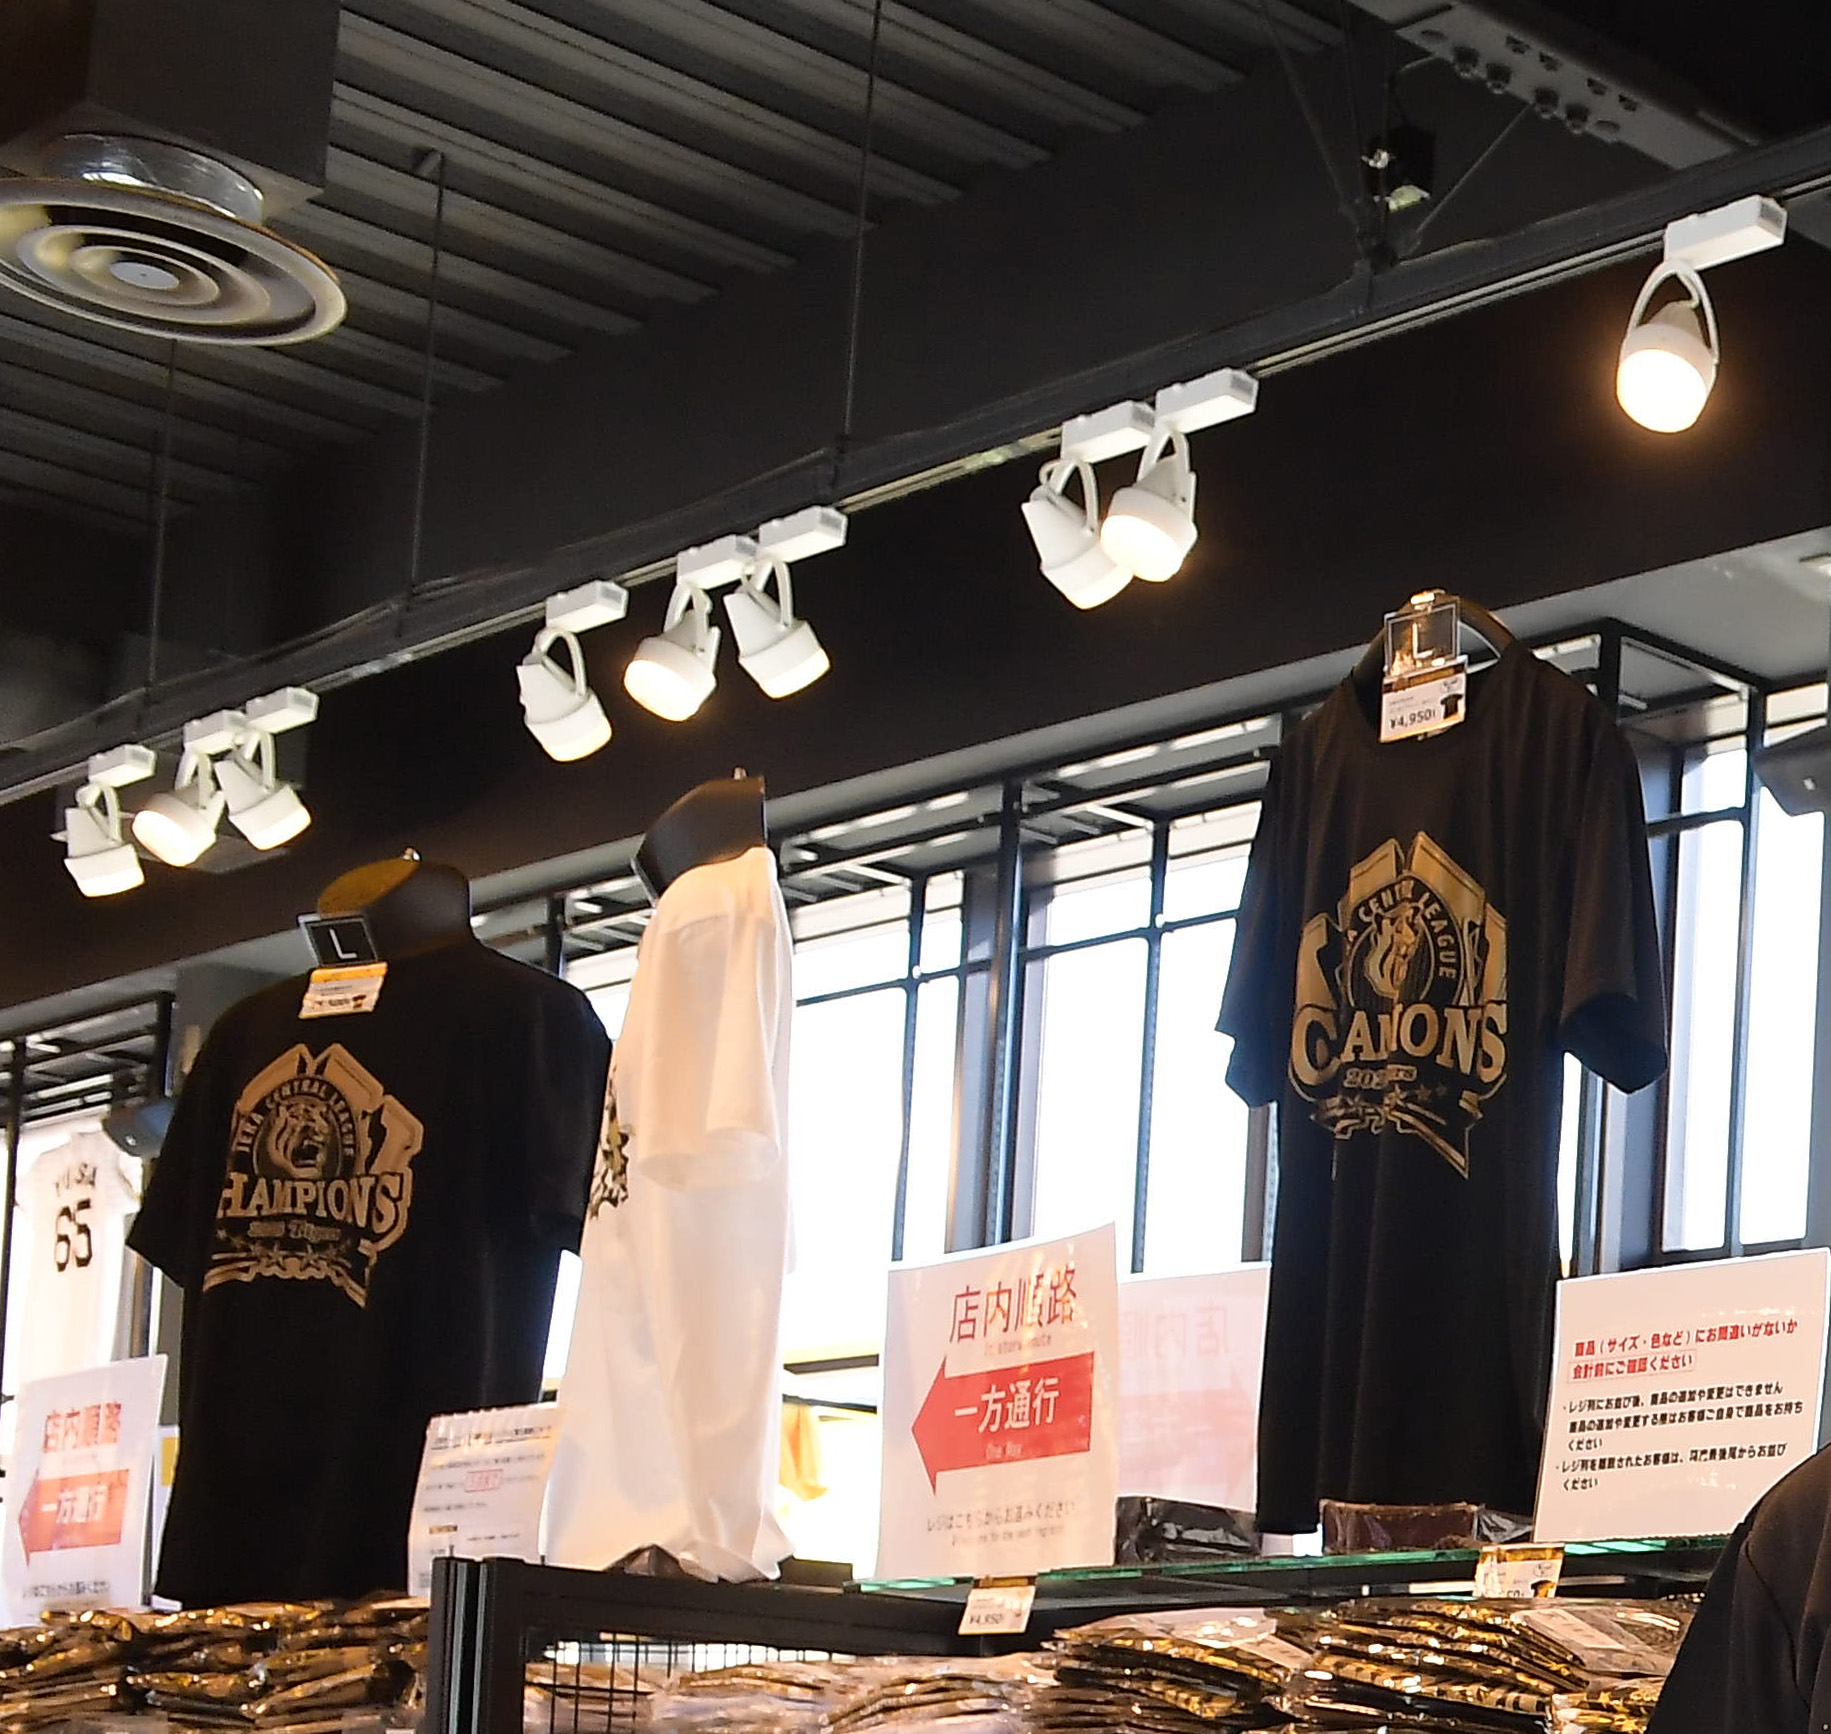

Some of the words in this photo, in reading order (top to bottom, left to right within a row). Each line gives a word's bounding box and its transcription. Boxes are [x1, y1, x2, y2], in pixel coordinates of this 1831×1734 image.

[328, 928, 358, 960] L
[54, 1198, 93, 1273] 65
[218, 1171, 401, 1236] HAMPIONS
[949, 1265, 1078, 1345] 店内順路
[954, 1375, 1060, 1434] 一方通行
